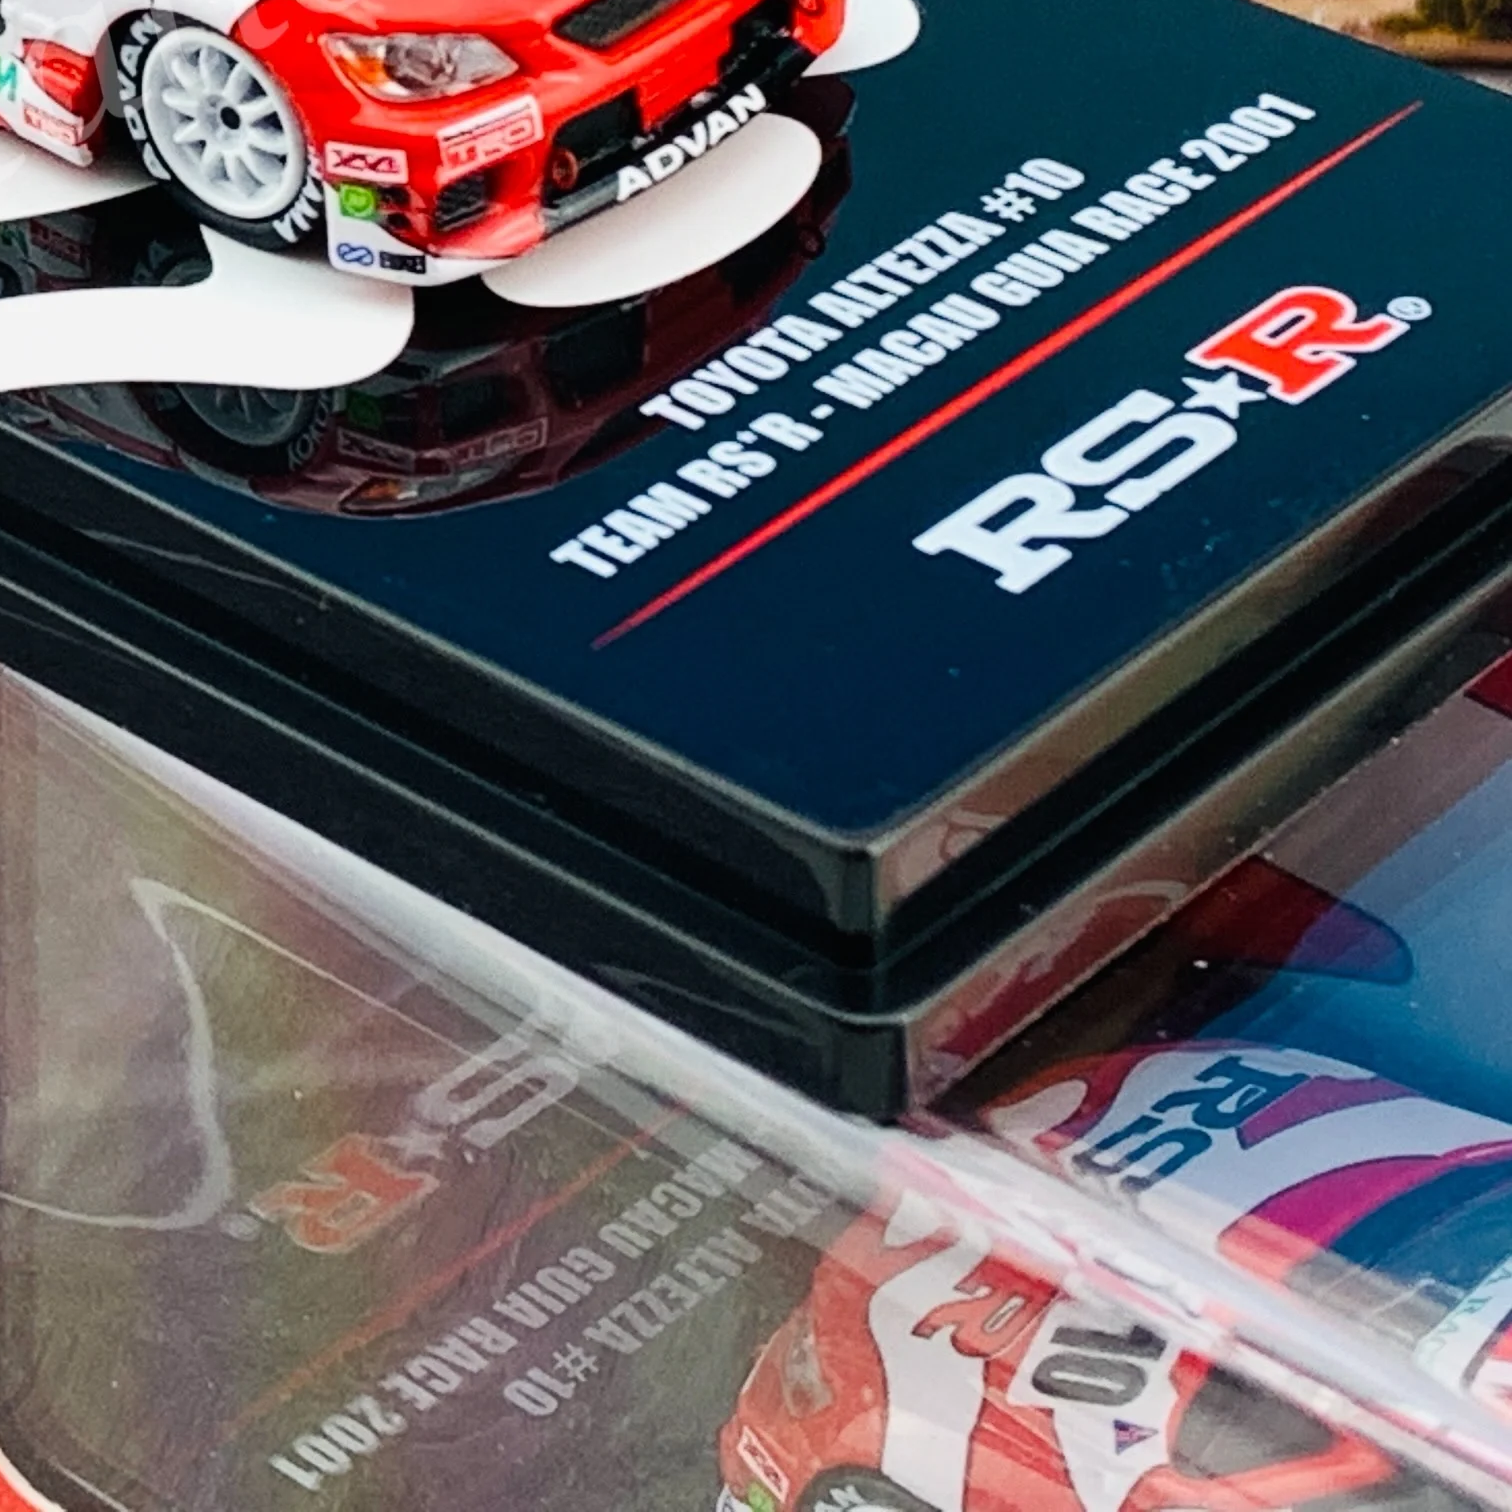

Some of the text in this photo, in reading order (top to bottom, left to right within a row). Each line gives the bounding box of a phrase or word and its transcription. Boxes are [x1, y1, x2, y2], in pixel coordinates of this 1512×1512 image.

[615, 83, 768, 202] ADVAN
[548, 481, 713, 579] TEAM
[812, 292, 1001, 410] MACAU
[969, 228, 1112, 308] GUIA
[1069, 156, 1217, 243] RACE
[1179, 92, 1317, 174] 2001
[638, 156, 1087, 431] TOYOTA ALTEZZA #10
[598, 1138, 763, 1260] MACAU
[491, 1247, 616, 1330] GUIA
[377, 1316, 520, 1413] RACE
[502, 1341, 600, 1417] #10
[1030, 1322, 1170, 1409] 10
[267, 1394, 408, 1491] 2001
